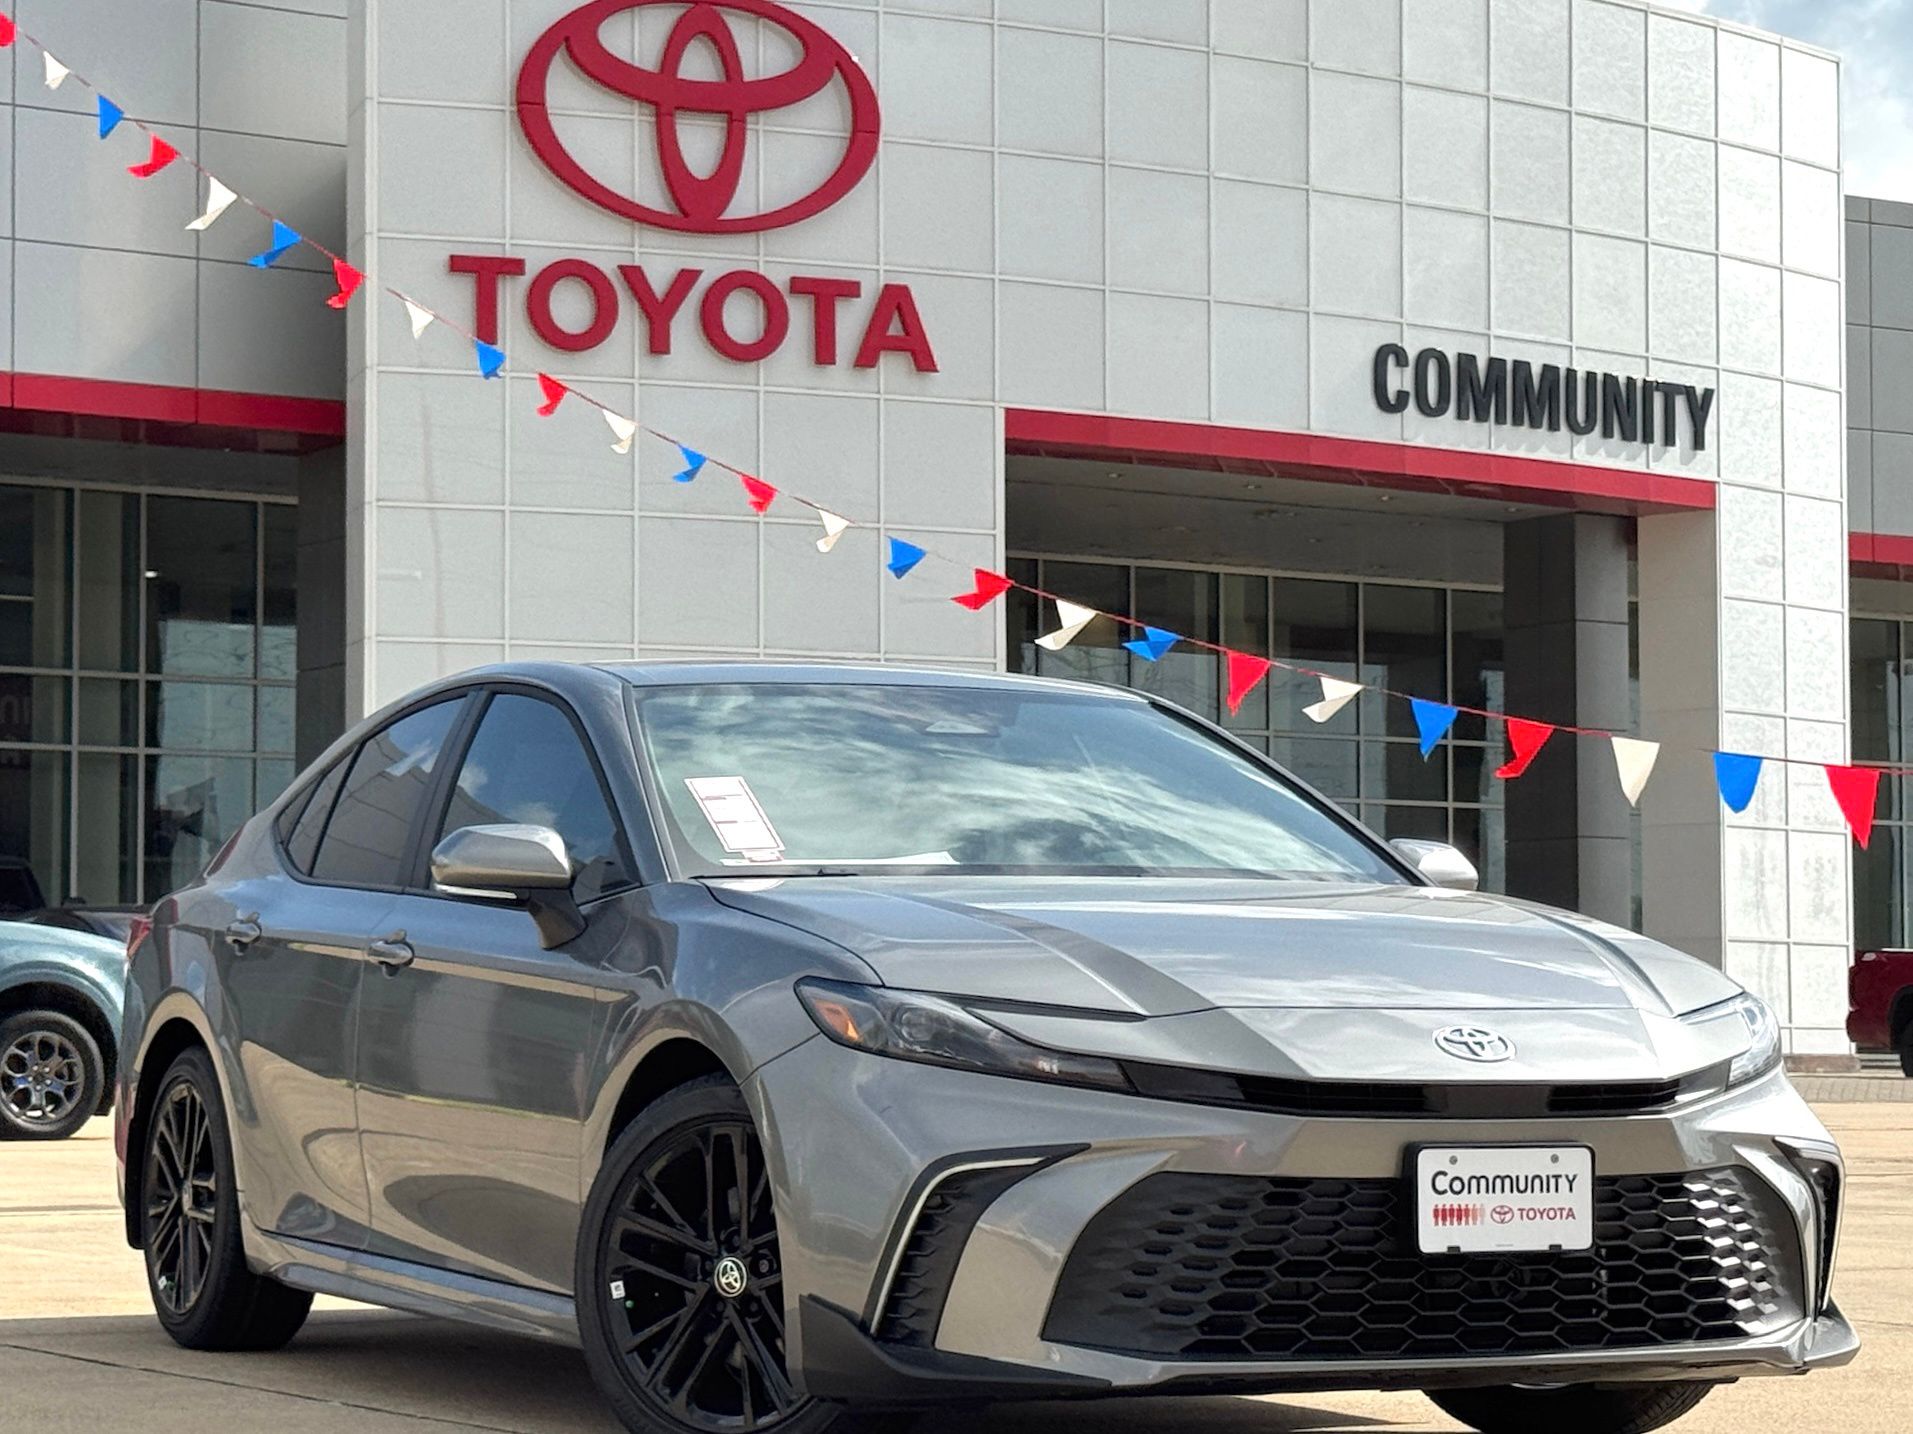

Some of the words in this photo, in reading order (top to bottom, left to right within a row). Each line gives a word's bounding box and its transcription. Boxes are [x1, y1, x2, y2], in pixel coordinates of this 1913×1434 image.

[449, 254, 939, 373] TOYOTA
[1373, 343, 1715, 451] COMMUNITY
[1517, 1208, 1577, 1221] TOYOTA
